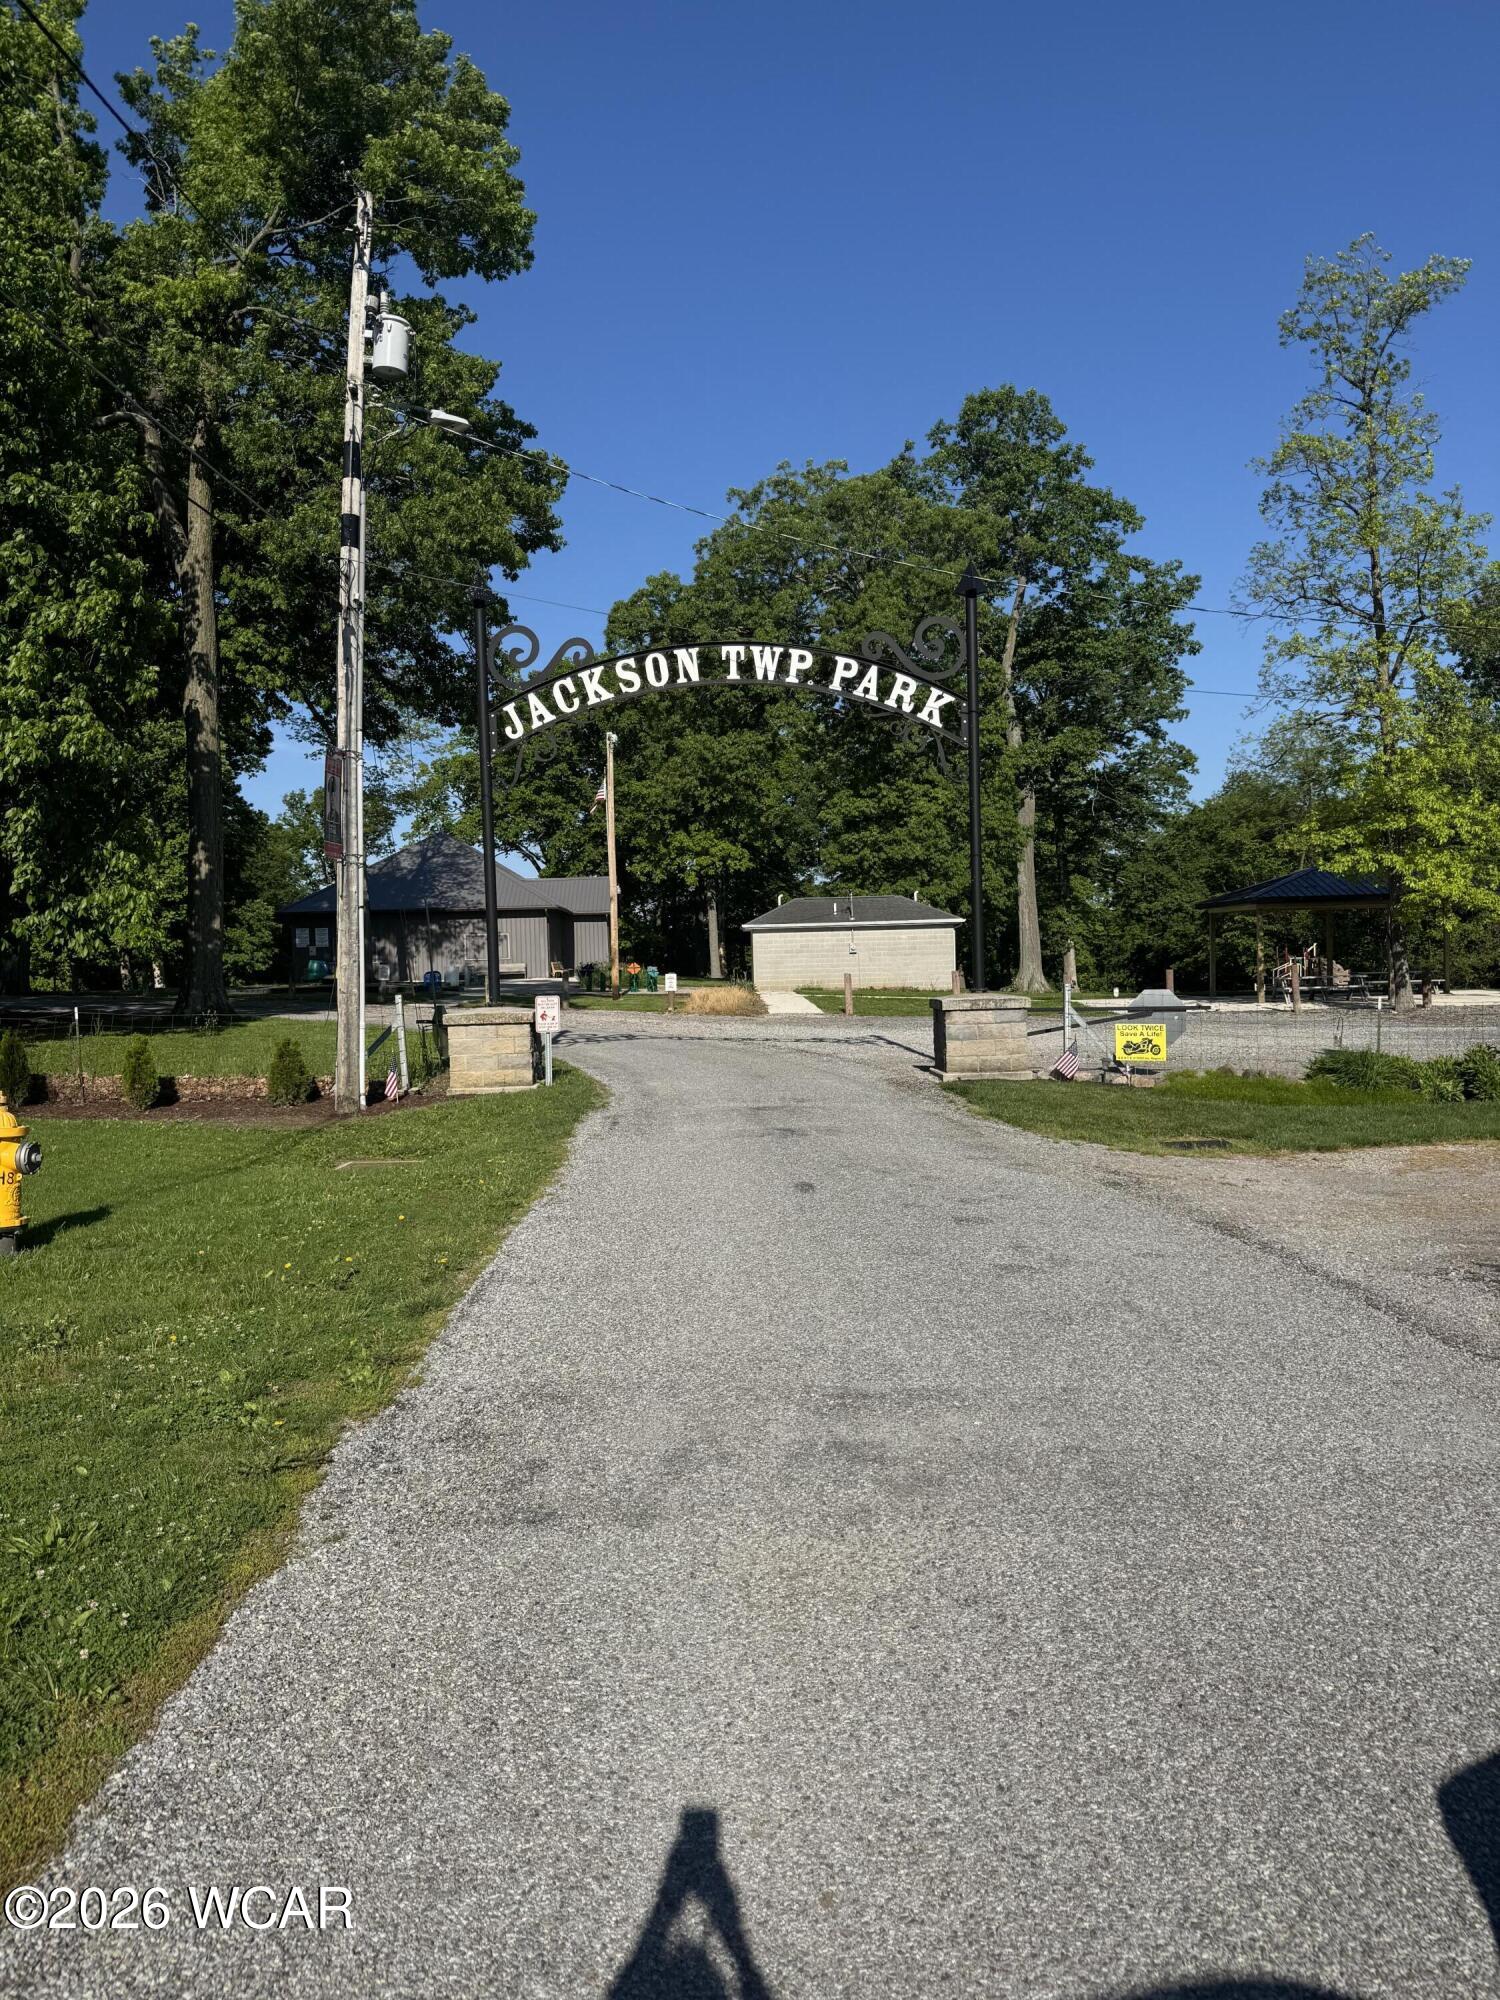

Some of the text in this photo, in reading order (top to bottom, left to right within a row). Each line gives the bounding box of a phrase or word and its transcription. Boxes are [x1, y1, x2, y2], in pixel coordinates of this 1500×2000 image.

[503, 645, 956, 740] JACKSON TWP. PARK
